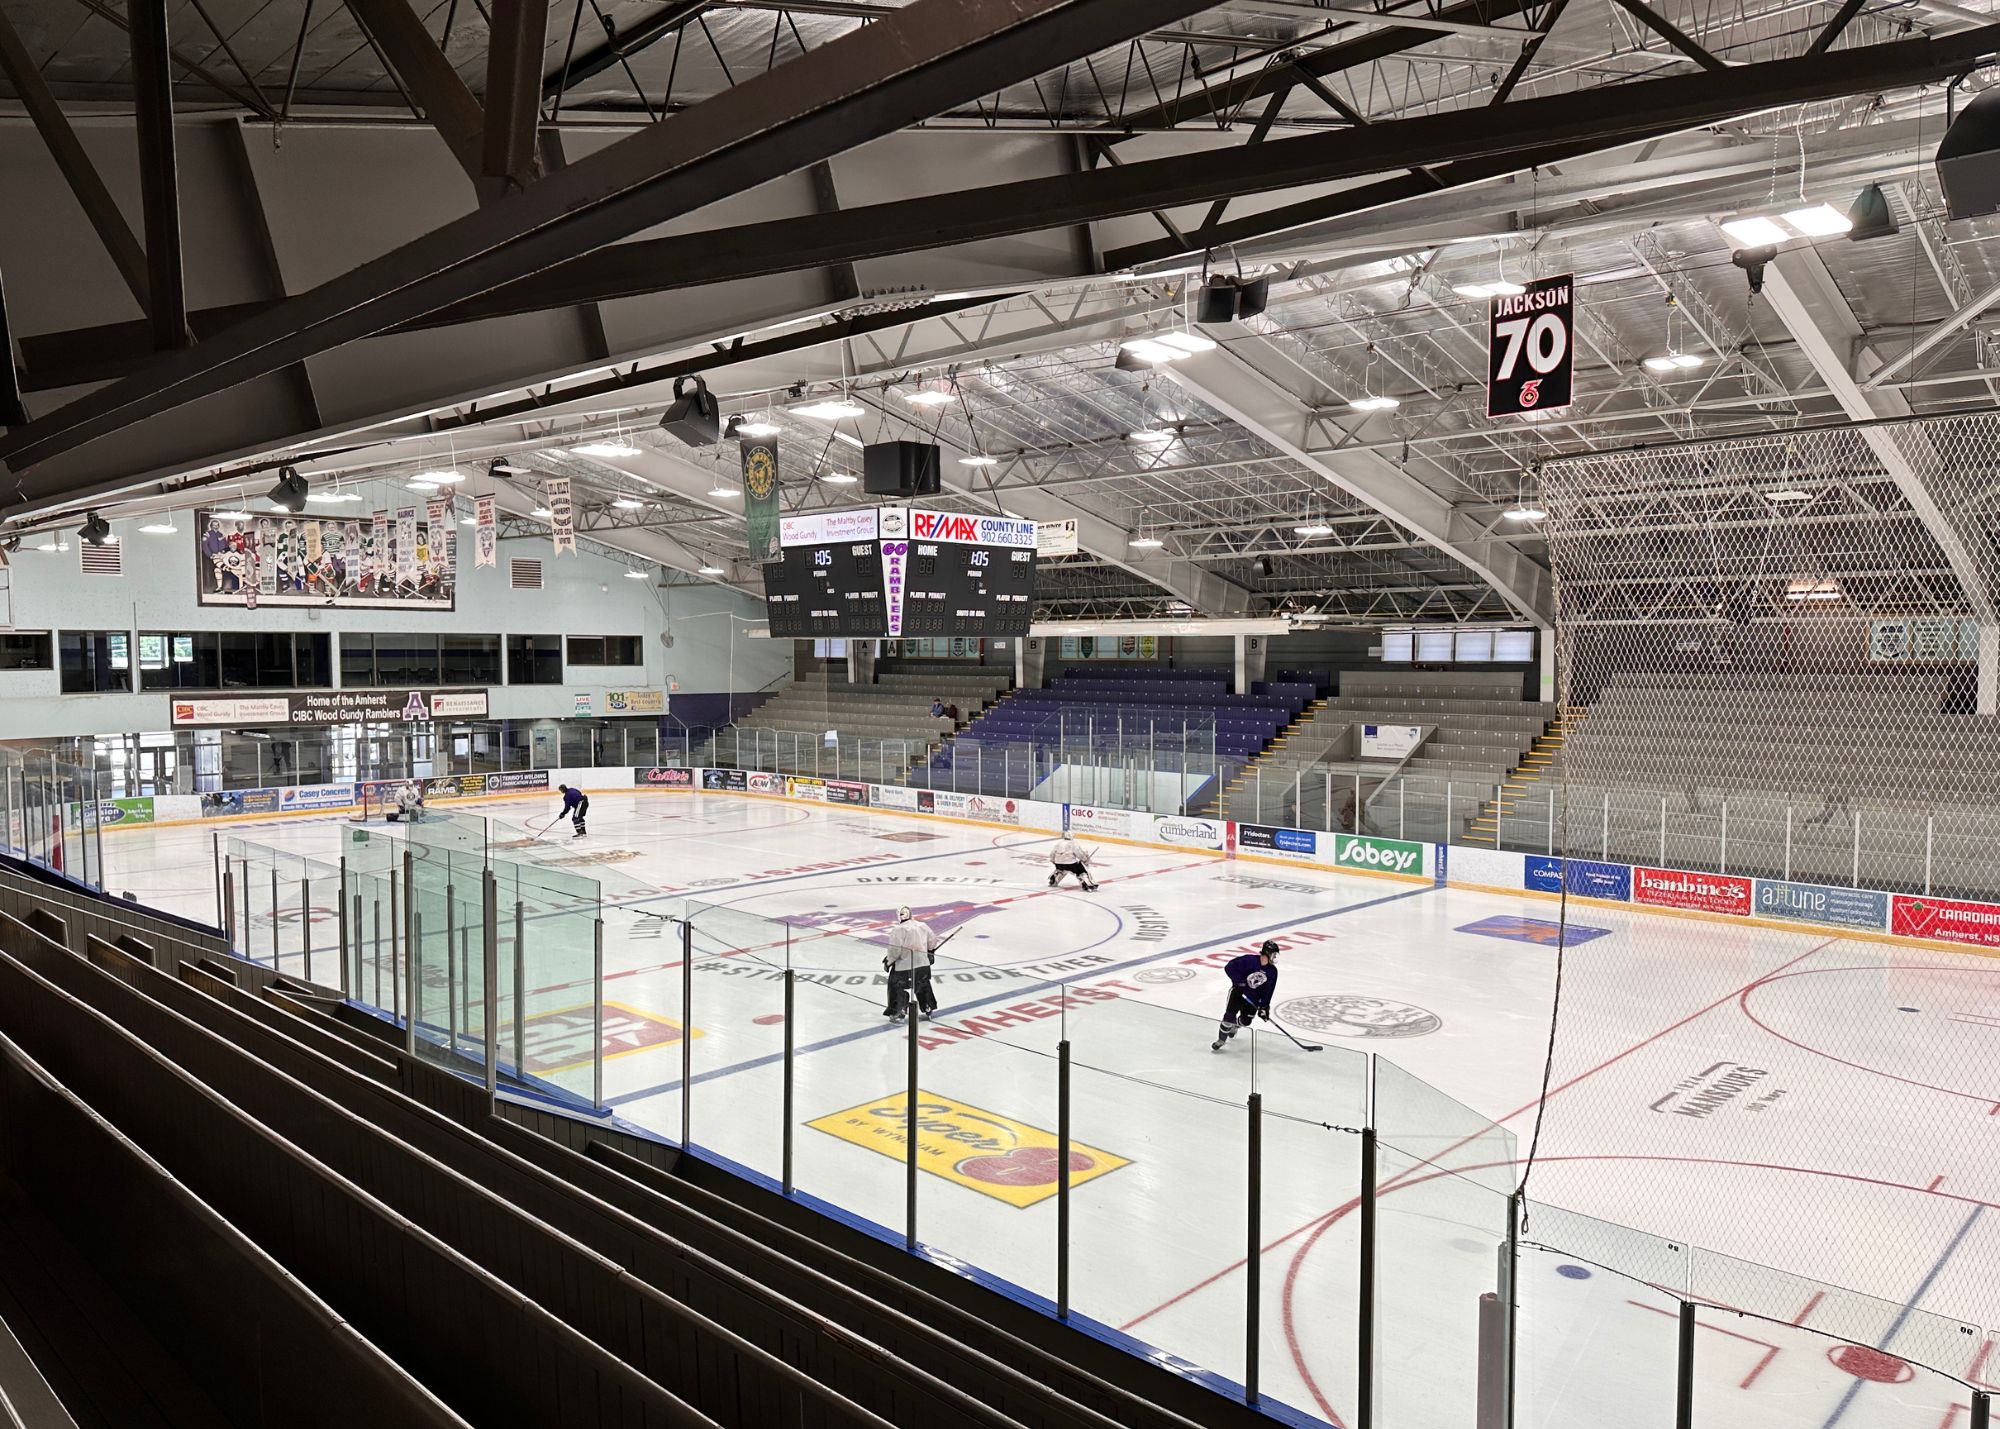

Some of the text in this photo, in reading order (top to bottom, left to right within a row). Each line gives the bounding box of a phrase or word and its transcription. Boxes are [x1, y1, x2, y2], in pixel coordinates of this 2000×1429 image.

[1495, 286, 1569, 317] JACKSON
[1496, 313, 1567, 381] 70
[827, 515, 873, 526] The Maltby Casey
[914, 513, 978, 541] RE/MAX
[826, 526, 874, 537] Investment Group
[981, 520, 1034, 535] COUNTY LINE
[783, 530, 817, 541] Wood Gundy
[981, 532, 1033, 545] 902.660.3325
[851, 544, 872, 556] GUEST
[917, 545, 938, 556] HOME
[1011, 551, 1031, 563] GUEST
[889, 557, 902, 632] RAMBLERS
[861, 641, 867, 649] A
[1030, 641, 1037, 649] B
[1251, 639, 1258, 649] B
[307, 694, 386, 706] Home of the Amherst
[292, 708, 400, 721] CIBC Wood Gundy Ramblers
[300, 787, 351, 798] Casey Concrete
[428, 787, 456, 795] RAMS
[1072, 808, 1086, 817] CIBC
[1160, 824, 1217, 840] cumberland
[1339, 838, 1416, 871] Sobeys
[742, 853, 904, 880] AMHERST
[857, 876, 1005, 885] DIVERSITY
[1534, 869, 1564, 880] COMPAS
[1641, 870, 1745, 899] bambino's
[1647, 889, 1679, 900] PIZZERIA
[1690, 894, 1706, 902] FINE
[1709, 896, 1737, 906] FOODS
[1762, 884, 1825, 910] attune
[1831, 890, 1860, 899] chiropractic
[1853, 900, 1873, 909] therapy
[1120, 905, 1171, 942] INCLUSION
[1940, 909, 2000, 925] CANADIAN
[1935, 928, 2000, 942] Amherst, NS
[903, 979, 1143, 1051] AMHERST
[1673, 1066, 1769, 1118] MANSOUR'S
[868, 1104, 1006, 1150] Super
[846, 1118, 945, 1156] BY WYNAM
